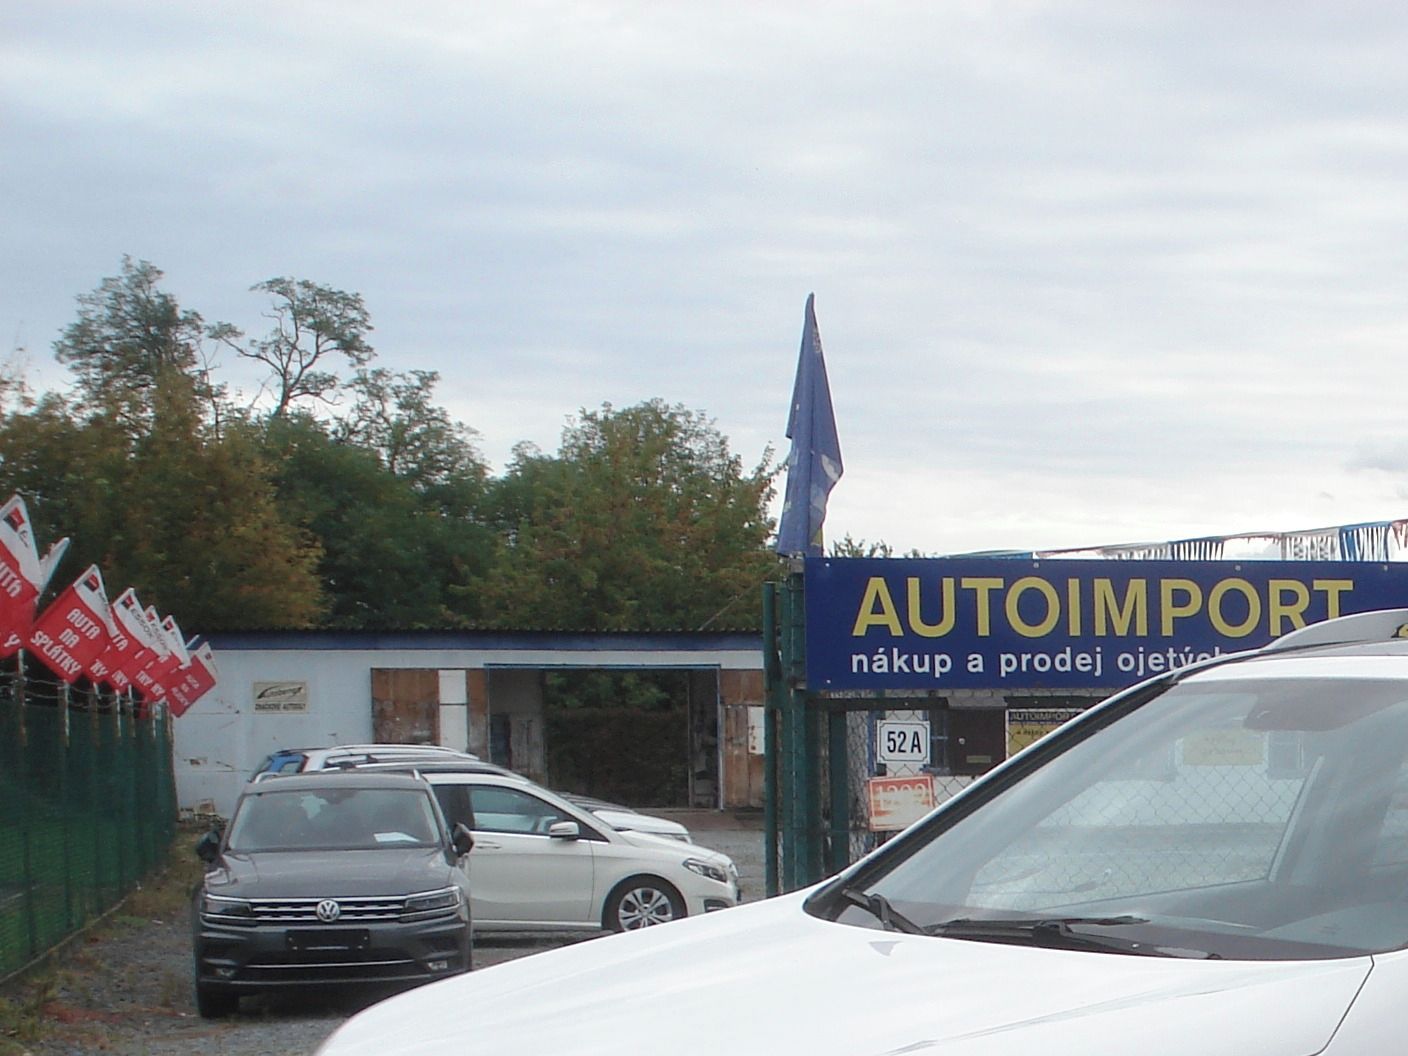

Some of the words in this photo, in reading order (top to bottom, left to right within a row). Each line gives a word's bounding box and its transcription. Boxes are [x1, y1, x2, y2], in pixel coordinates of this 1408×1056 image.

[851, 575, 1355, 639] AUTOIMPORT
[851, 646, 952, 678] nákup
[966, 652, 985, 673] a
[999, 646, 1102, 678] prodej
